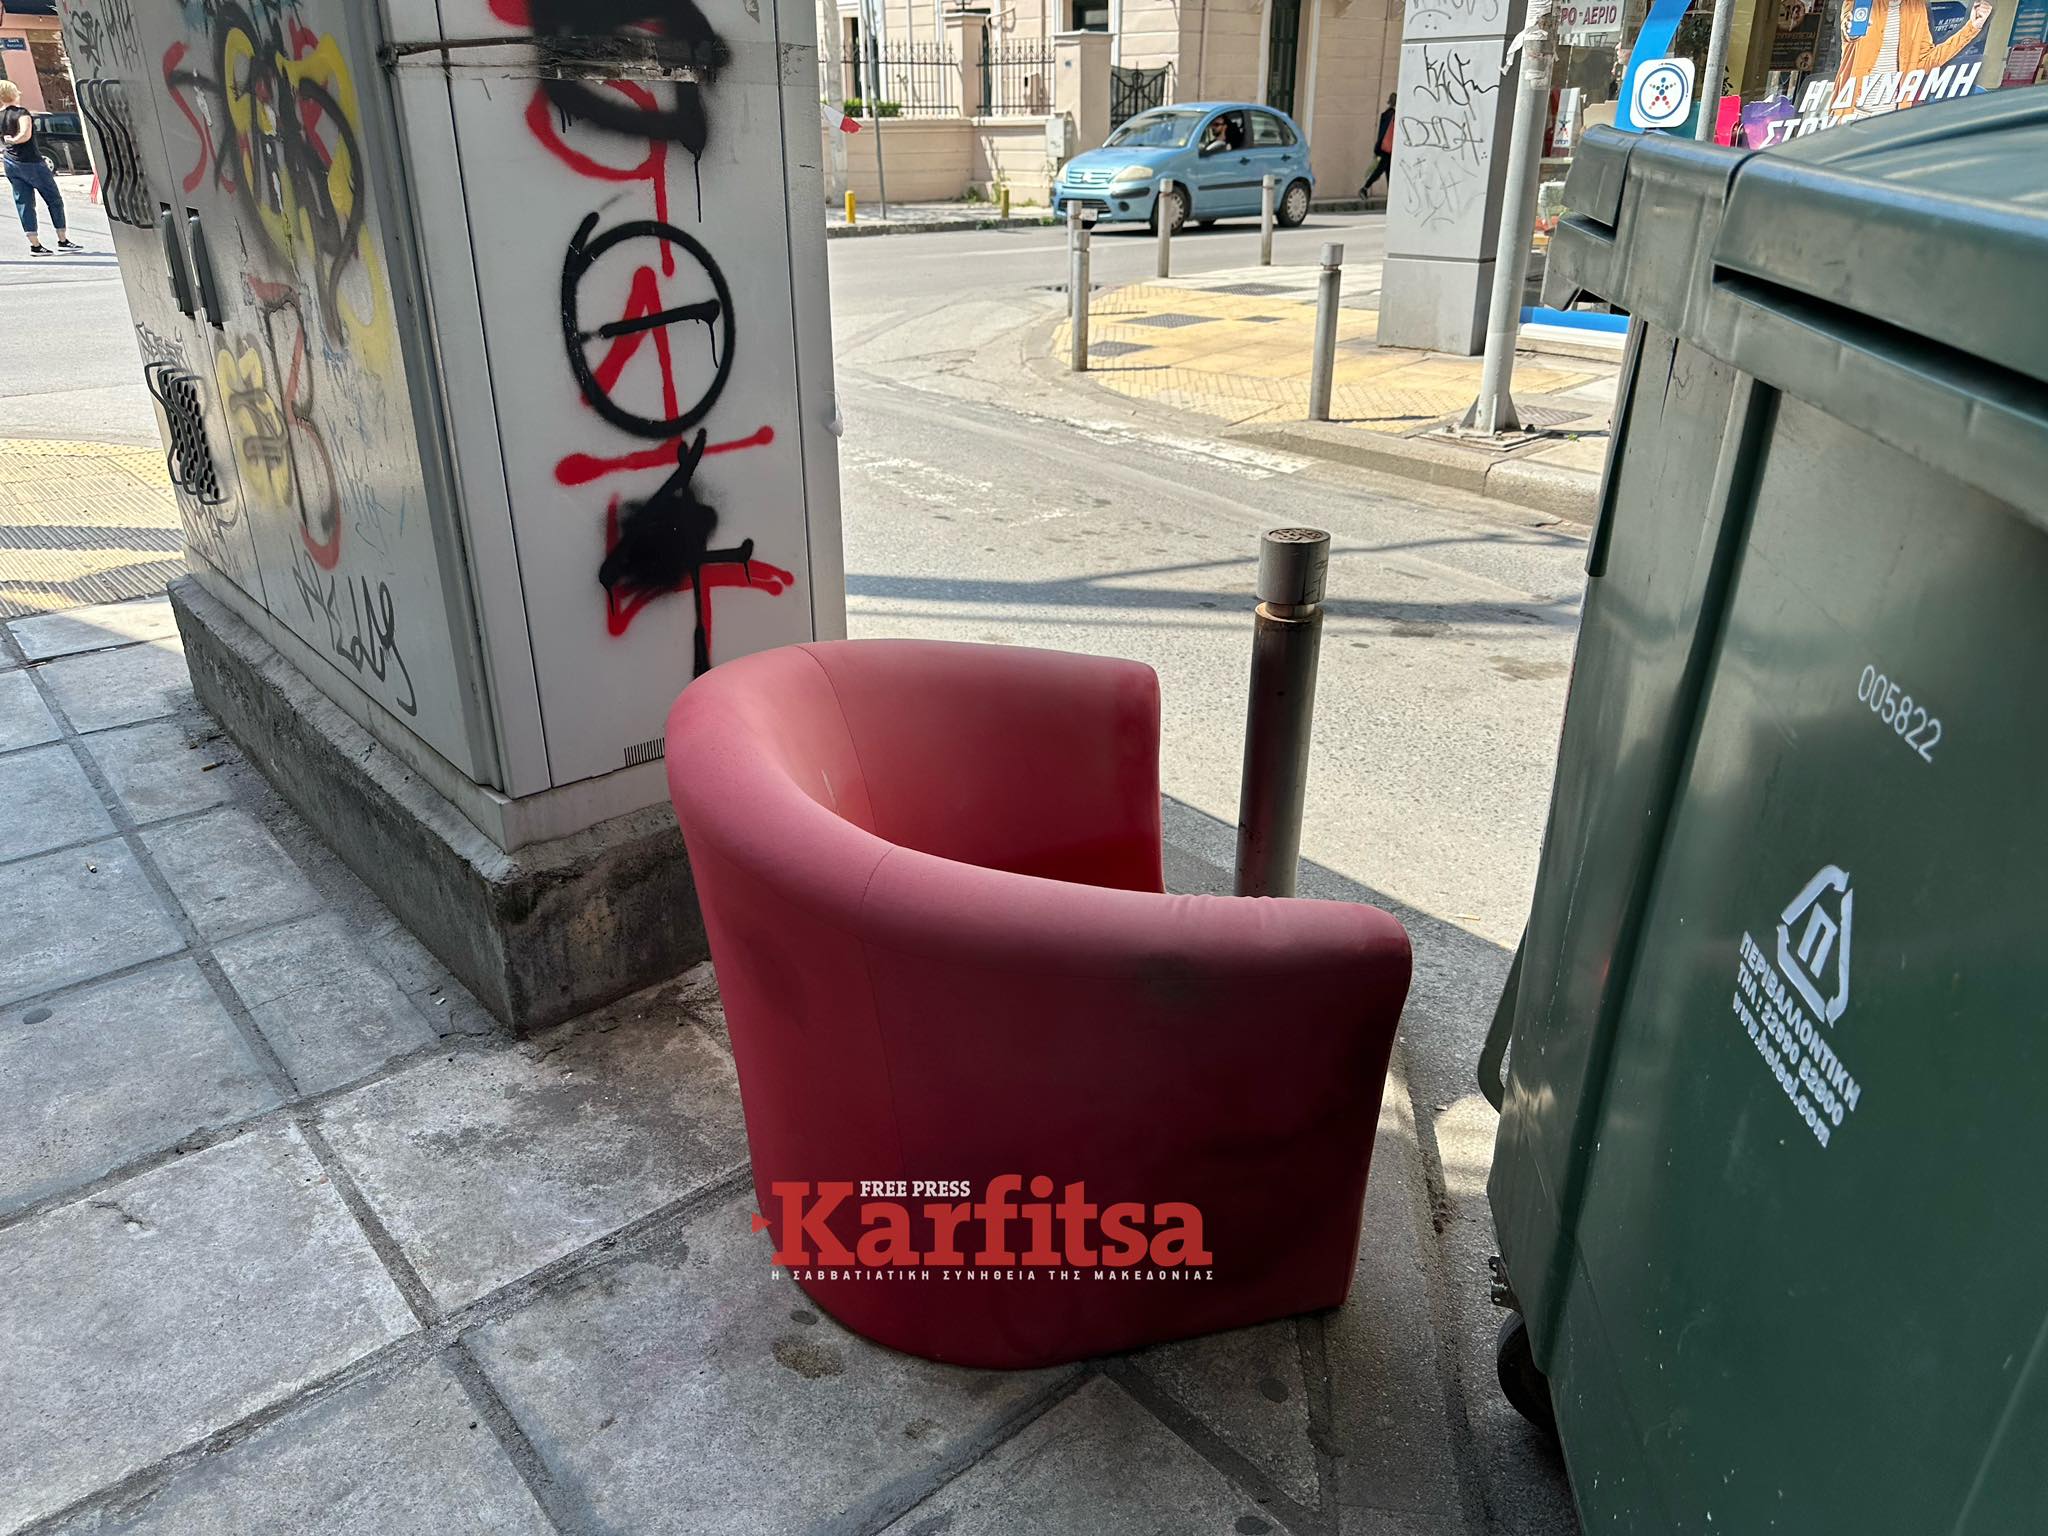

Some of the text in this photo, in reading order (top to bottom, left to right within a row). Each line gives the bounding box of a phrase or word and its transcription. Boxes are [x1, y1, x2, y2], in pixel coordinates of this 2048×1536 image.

[1560, 5, 1618, 26] ΡΟ-ΑΕΡΙΟ
[1798, 80, 1830, 113] Η
[1830, 62, 1982, 110] ΔΥΝΑΜΗ
[1858, 664, 1942, 763] 005822
[1739, 929, 1862, 1112] ΠΕΡΙΒΑΛΛΟΝΤΙΚΗ
[1760, 1001, 1801, 1065] 22990
